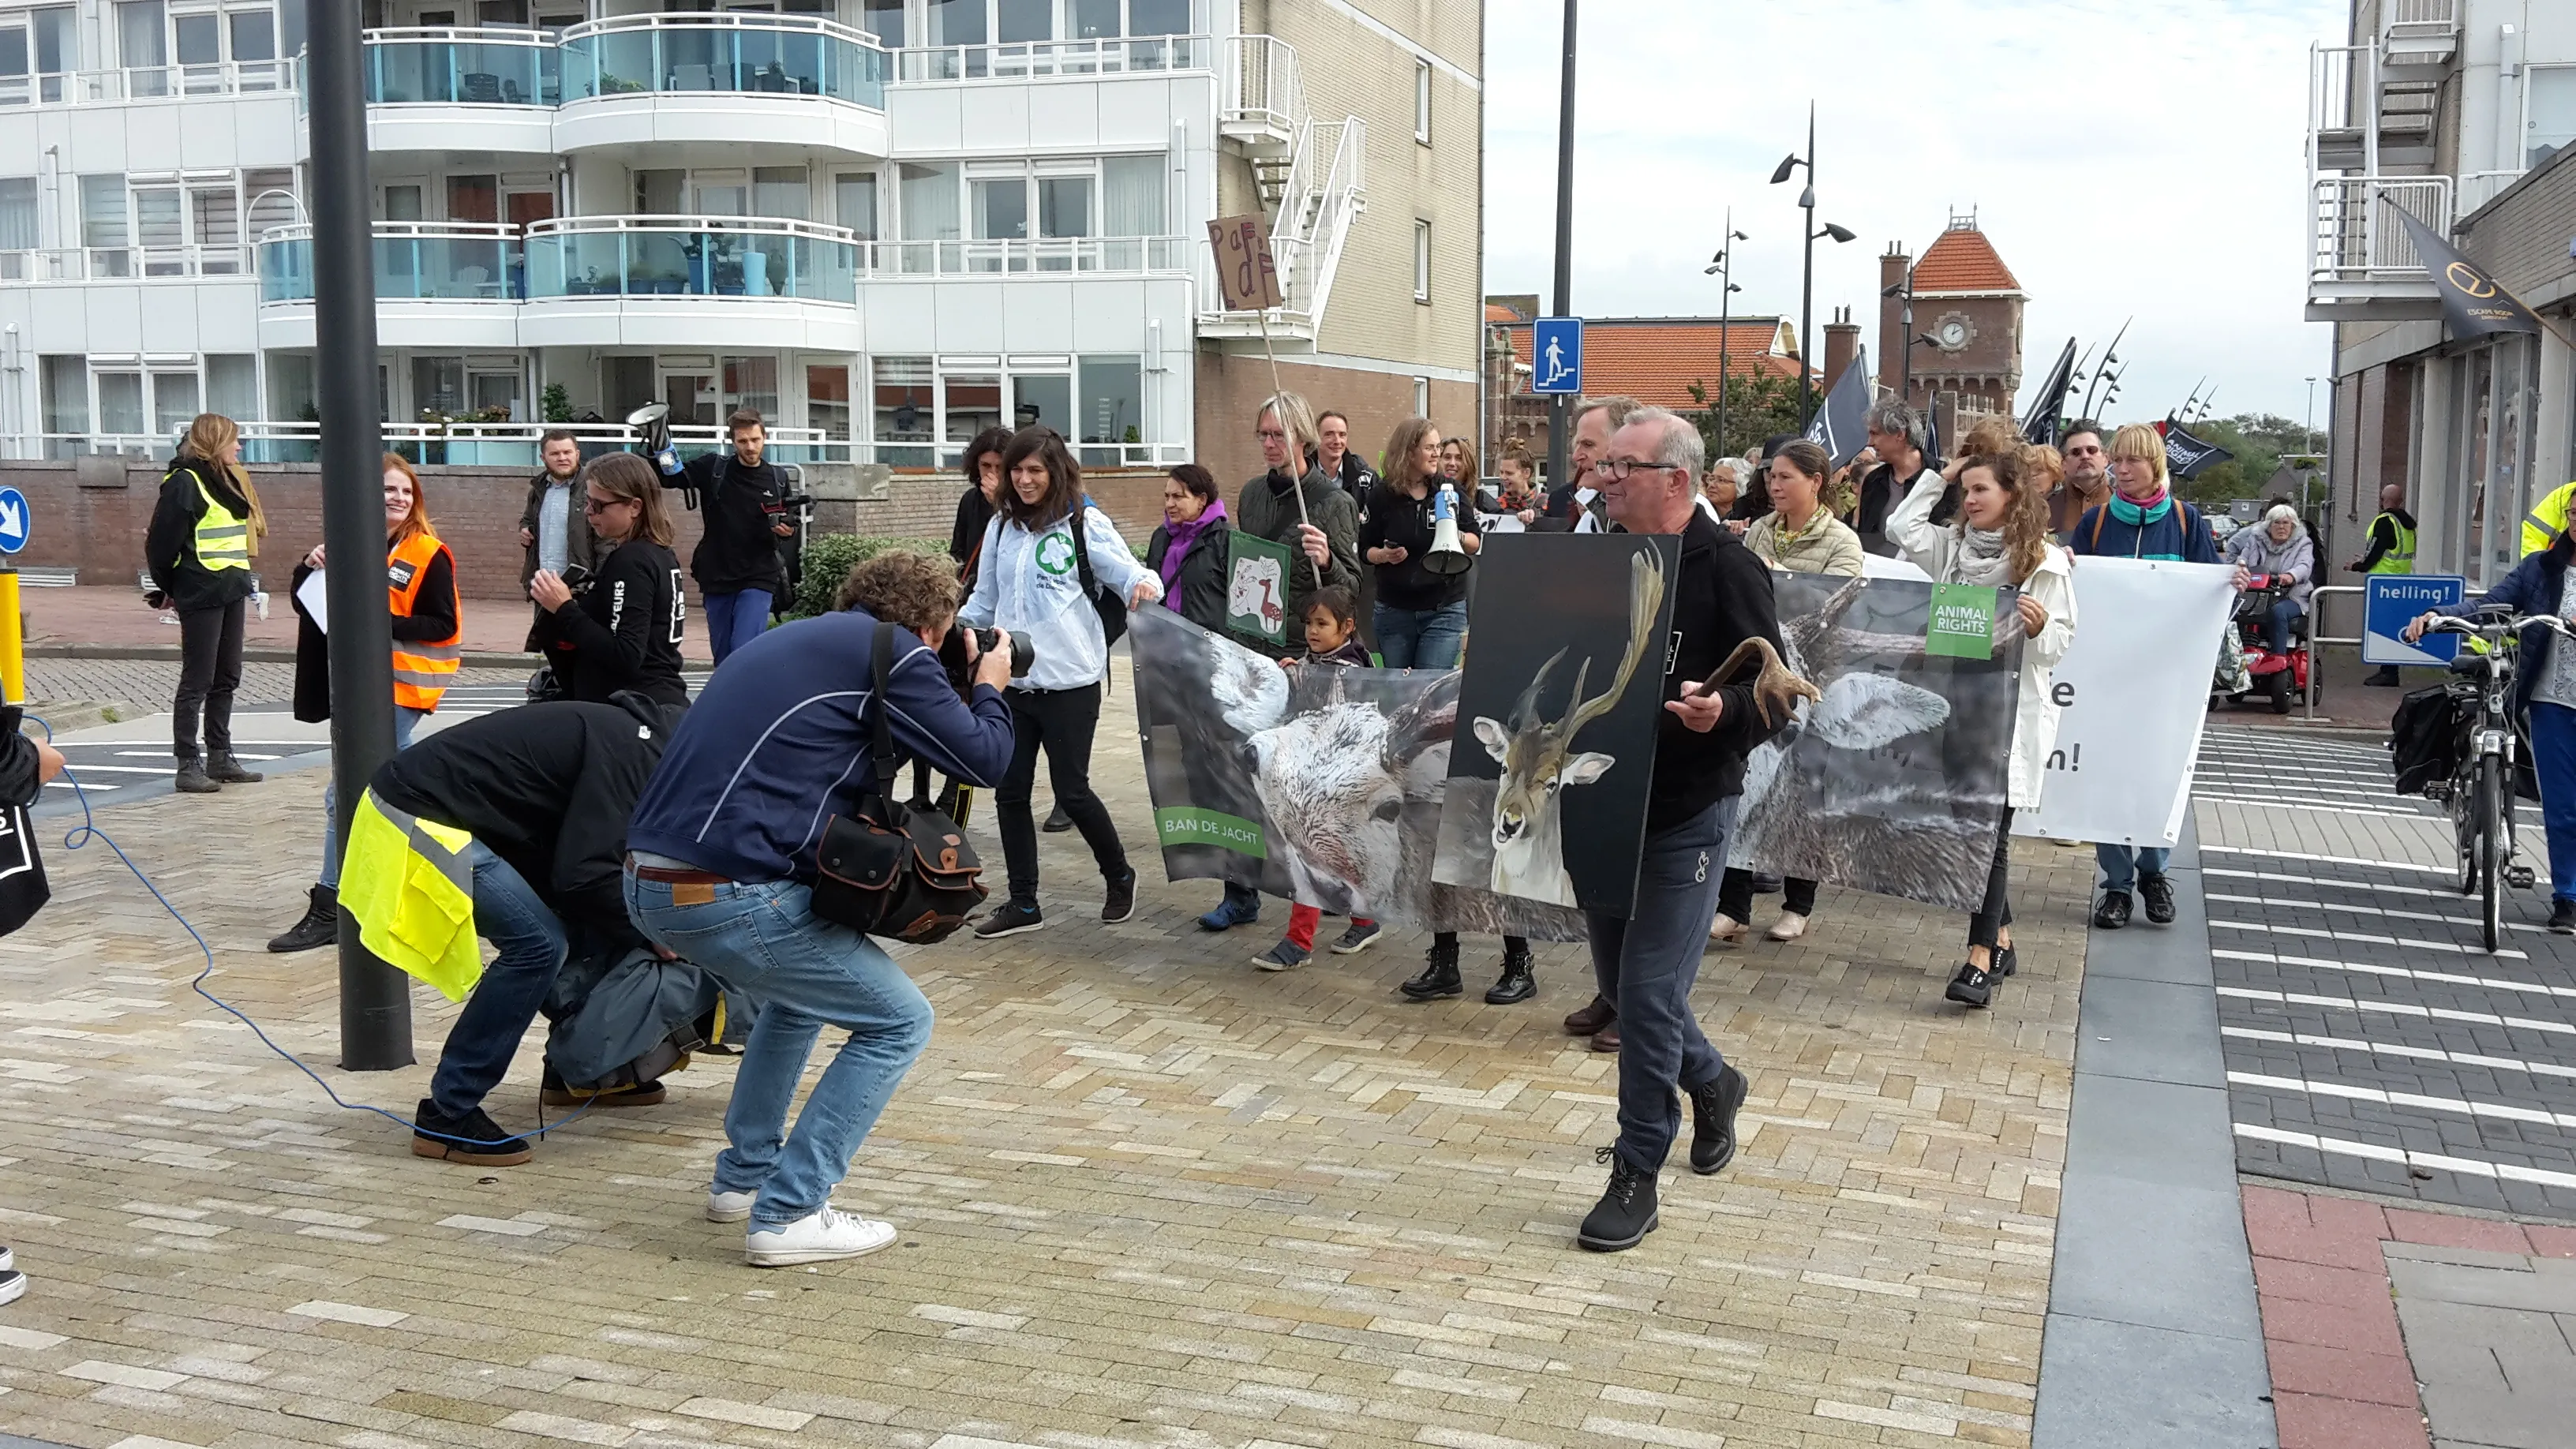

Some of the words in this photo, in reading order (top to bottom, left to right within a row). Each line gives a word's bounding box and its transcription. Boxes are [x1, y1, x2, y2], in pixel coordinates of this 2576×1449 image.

[2166, 439, 2200, 458] ANIMAL
[2379, 585, 2450, 604] helling!
[1935, 605, 1989, 621] ANIMAL
[1938, 617, 1986, 634] RIGHTS
[1165, 818, 1197, 833] BAN
[1202, 820, 1219, 834] DE
[1222, 826, 1258, 845] JACHT
